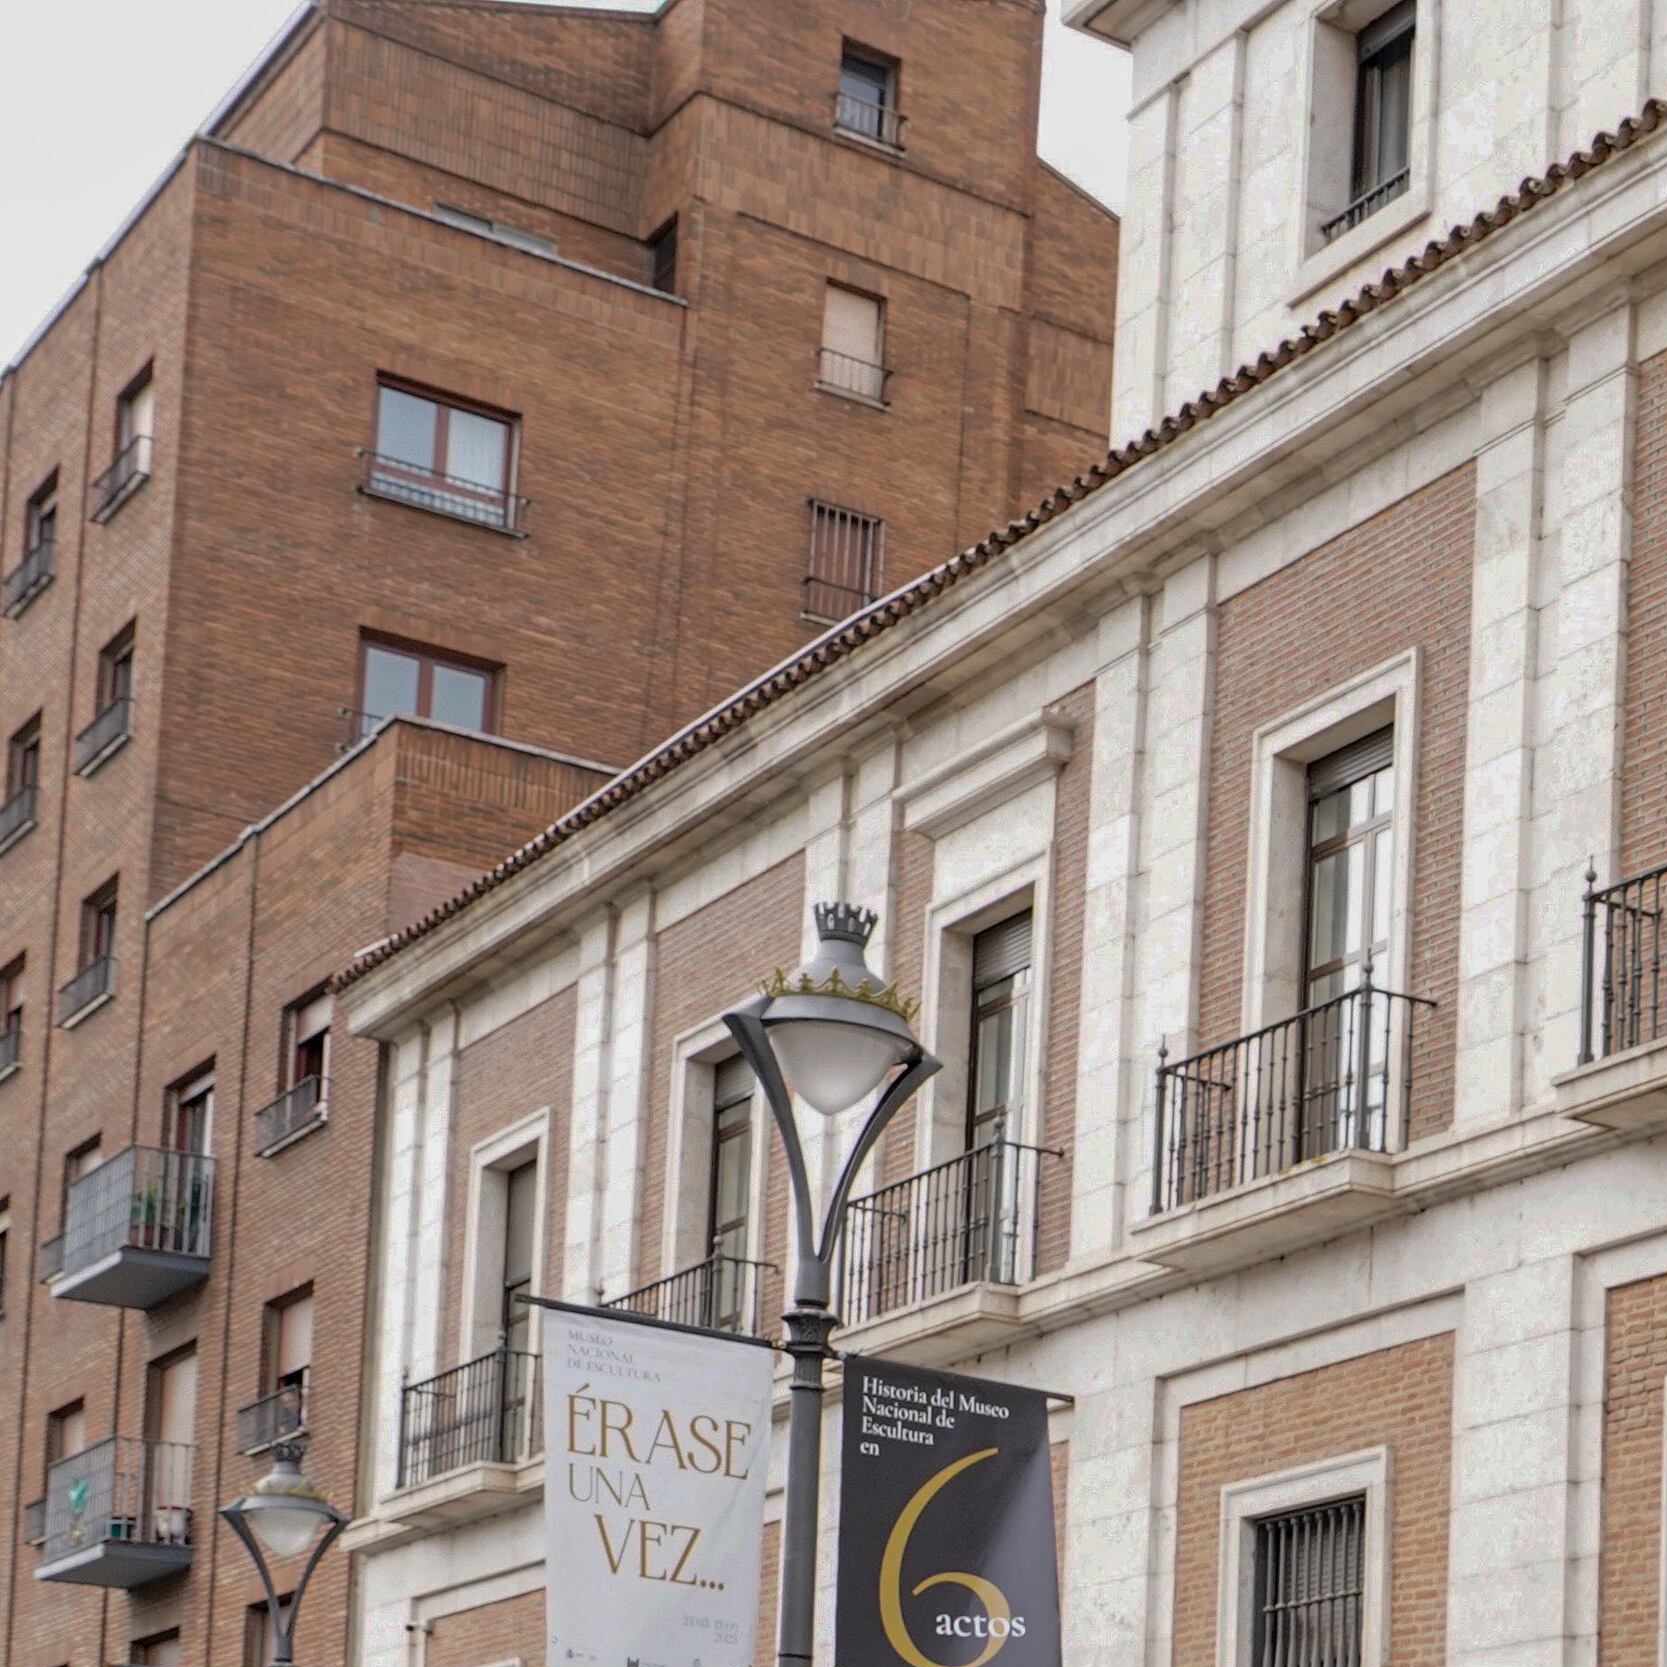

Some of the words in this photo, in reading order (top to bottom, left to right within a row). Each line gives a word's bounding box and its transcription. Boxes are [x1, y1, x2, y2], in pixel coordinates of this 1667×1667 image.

[862, 1376, 927, 1405] Historia
[931, 1388, 954, 1410] del
[959, 1393, 1010, 1419] Museo
[862, 1396, 932, 1426] Nacional
[936, 1408, 955, 1429] de
[567, 1383, 751, 1480] ÉRASE
[860, 1441, 880, 1457] en
[861, 1416, 934, 1446] Escultura
[568, 1463, 651, 1511] UNA
[594, 1514, 725, 1591] VEZ...
[935, 1613, 1026, 1638] actos
